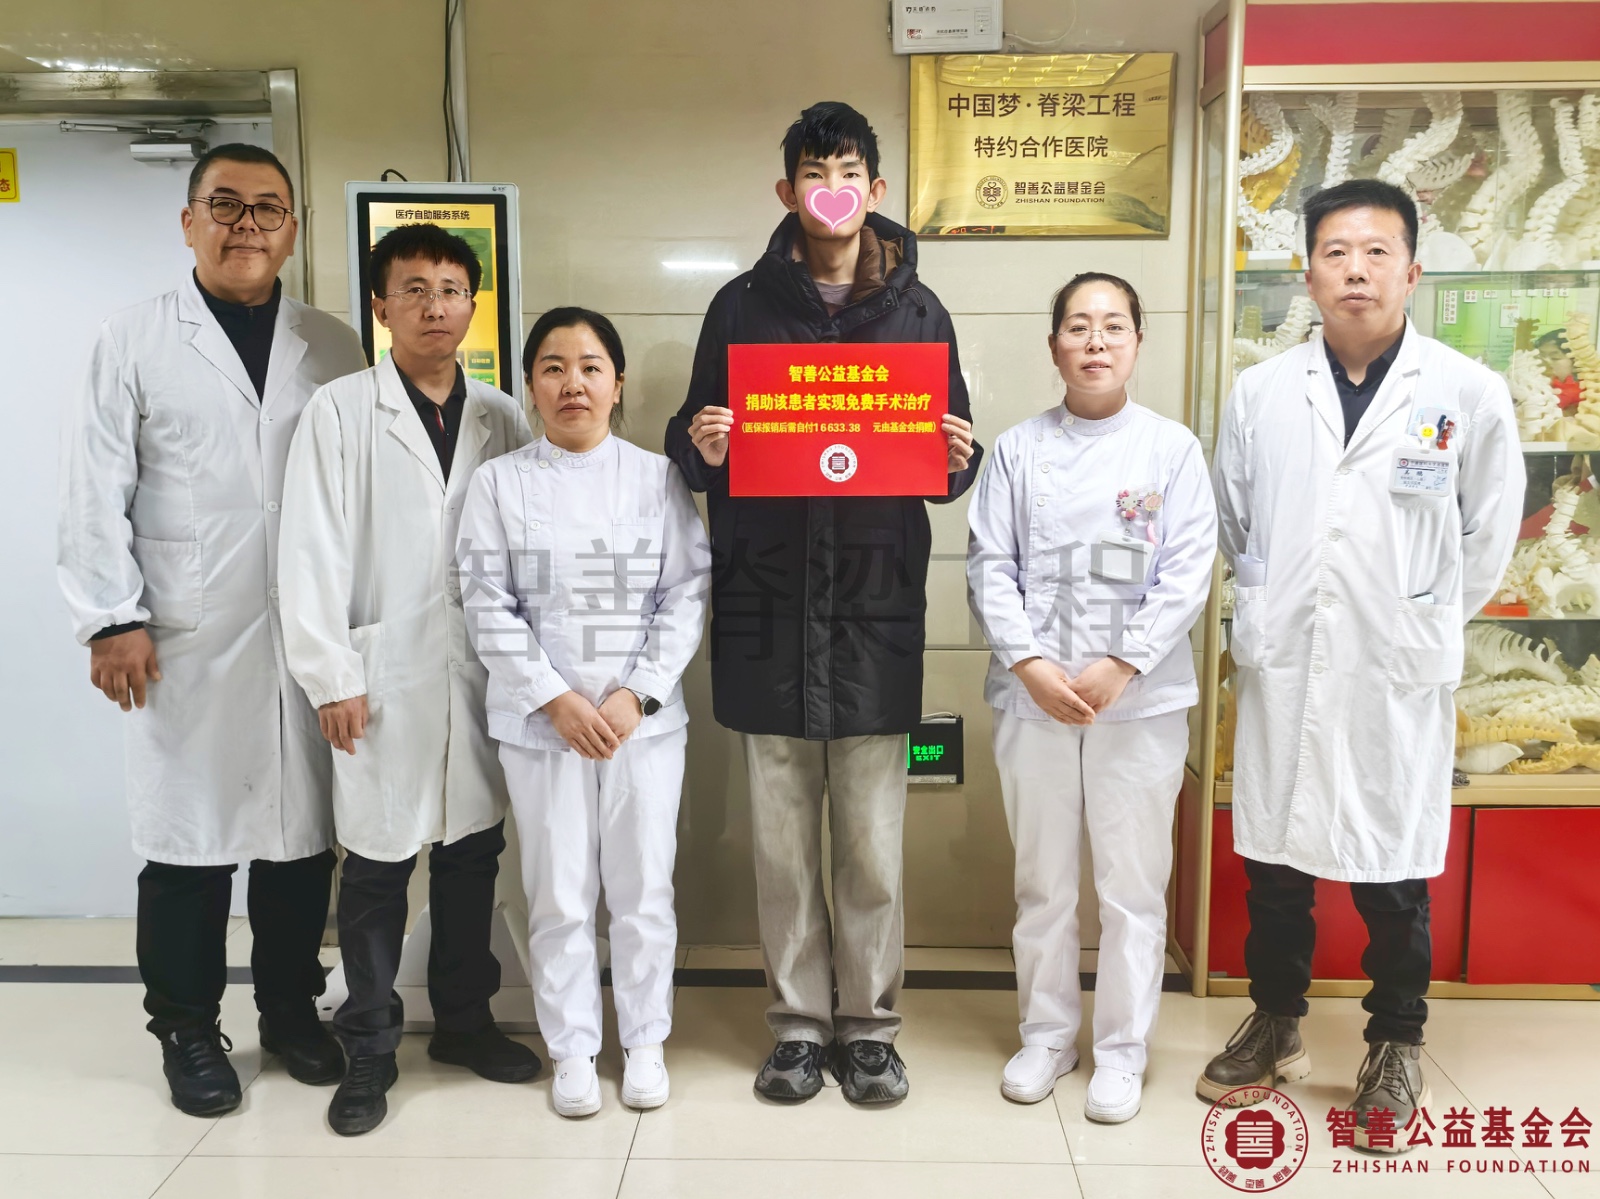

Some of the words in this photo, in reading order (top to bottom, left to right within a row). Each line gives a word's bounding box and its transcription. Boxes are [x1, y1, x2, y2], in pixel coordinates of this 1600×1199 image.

[948, 92, 1136, 118] 中国梦·脊梁工程
[974, 135, 1109, 158] 特约合作医院
[1014, 181, 1106, 195] 智善公益基金会
[395, 209, 470, 220] 医疗自助服务系统
[788, 364, 890, 383] 智善公益基金会
[745, 393, 932, 411] 捐助该患者实现免费手术治疗
